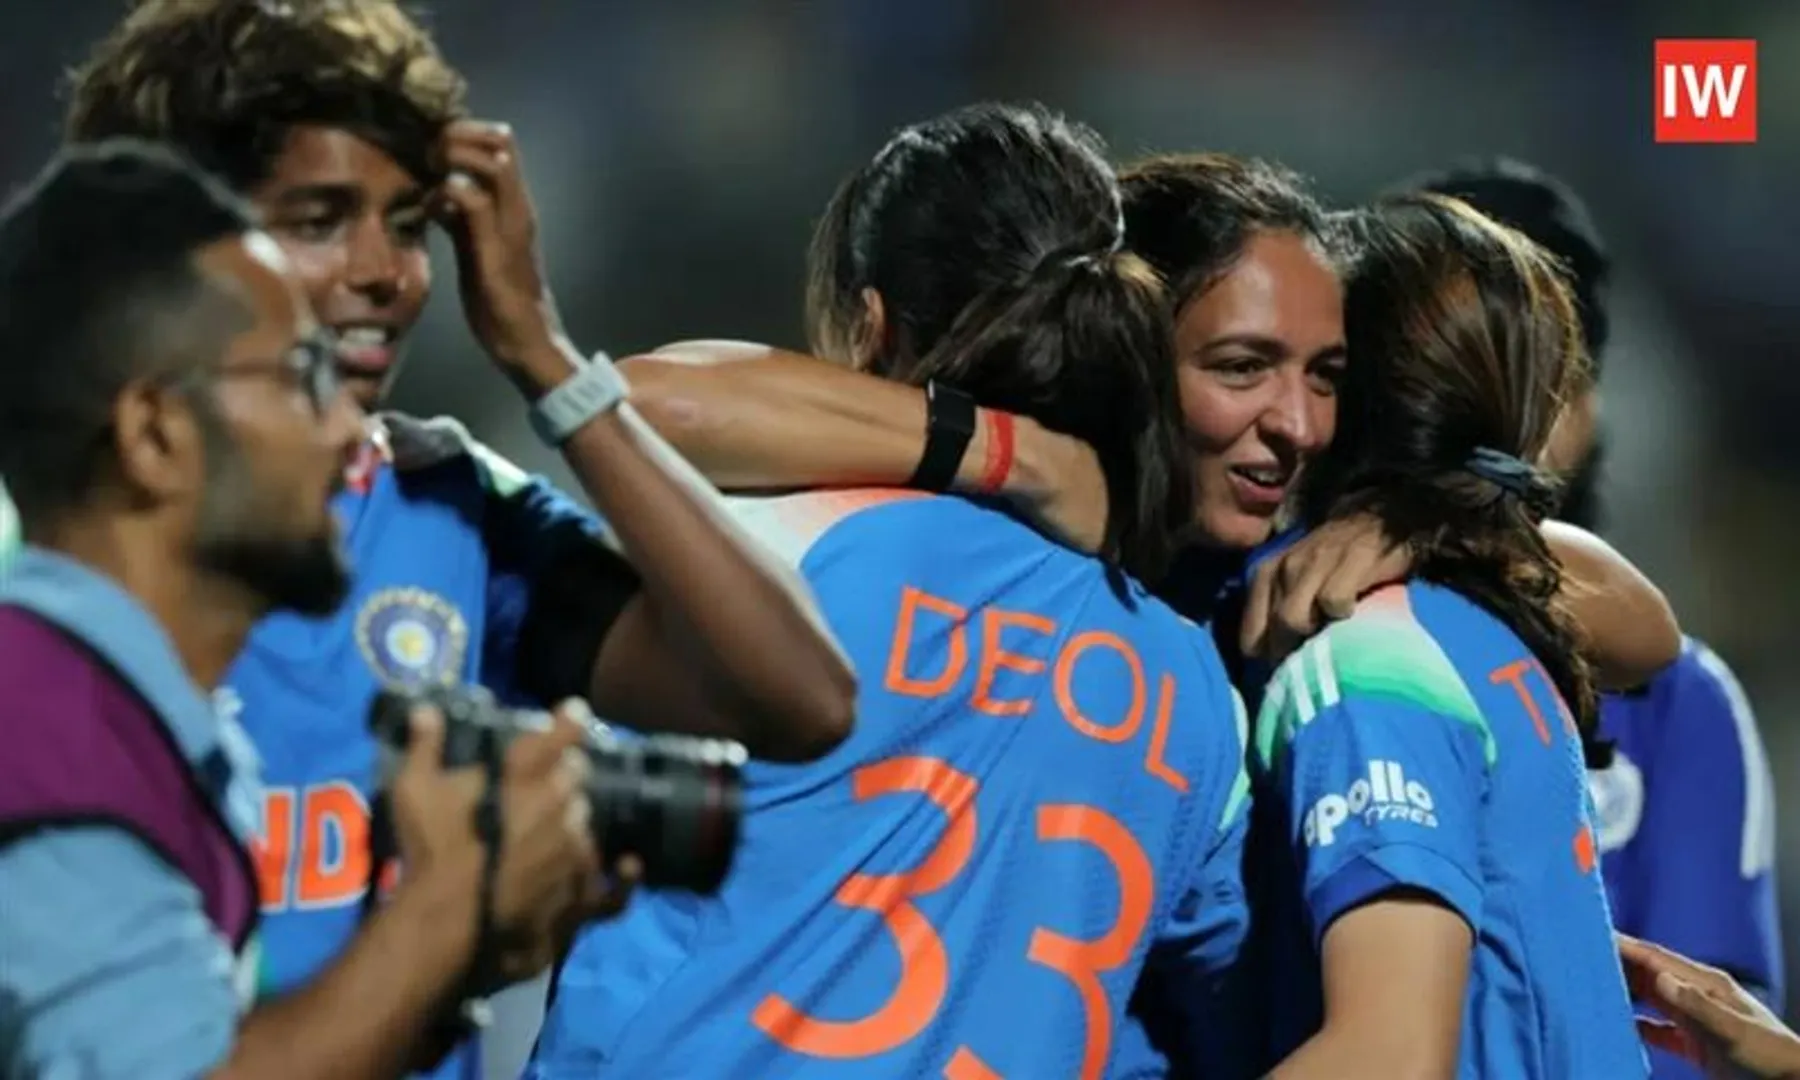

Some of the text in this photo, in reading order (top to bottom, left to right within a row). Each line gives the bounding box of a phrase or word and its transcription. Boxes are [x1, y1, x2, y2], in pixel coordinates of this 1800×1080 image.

[885, 585, 1189, 792] DEOL
[247, 780, 400, 913] ND
[1304, 759, 1434, 847] apollo
[1364, 803, 1439, 829] TYRES
[750, 755, 1154, 1080] 33
